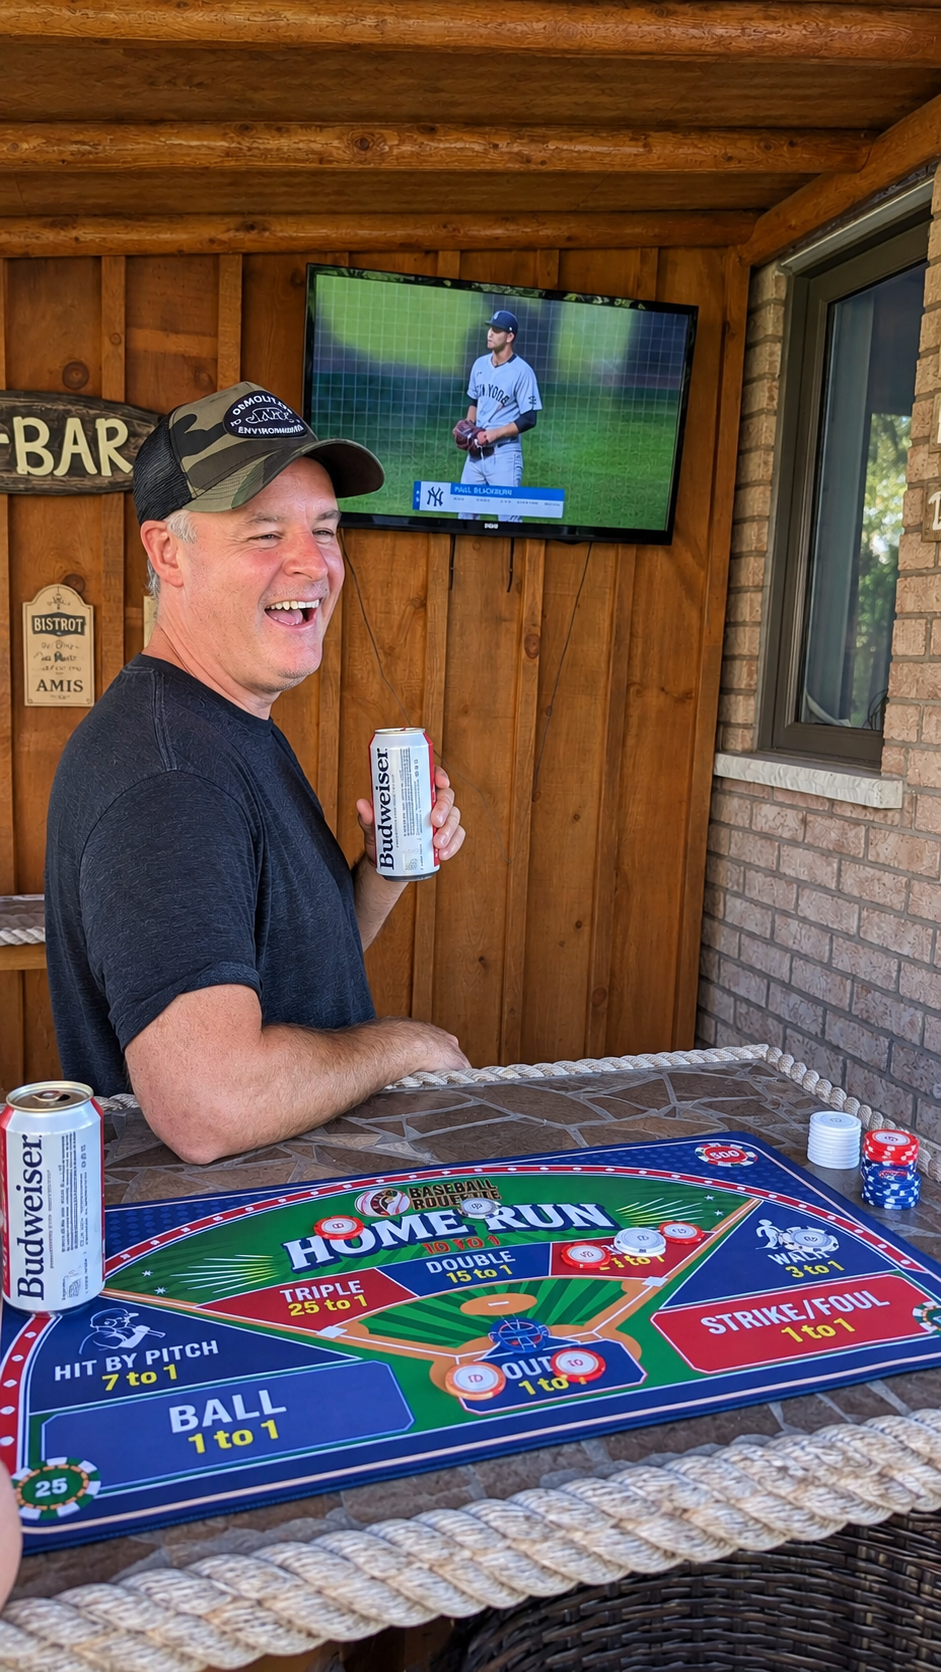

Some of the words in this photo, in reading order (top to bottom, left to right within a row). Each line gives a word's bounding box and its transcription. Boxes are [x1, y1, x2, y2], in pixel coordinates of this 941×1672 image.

[34, 617, 83, 632] BISTROT
[36, 679, 83, 693] AMIS
[376, 748, 395, 870] Budweiser
[408, 1178, 498, 1199] BASEBALL
[16, 1134, 44, 1301] Budweiser
[282, 1209, 469, 1271] HOME
[485, 1202, 615, 1231] RUN
[426, 1251, 516, 1274] DOUBLE
[446, 1271, 463, 1284] 15
[472, 1267, 498, 1280] to
[501, 1264, 513, 1276] 1
[785, 1266, 804, 1278] 3
[804, 1264, 829, 1275] to
[828, 1260, 845, 1271] 1
[280, 1280, 364, 1303] TRIPLE
[288, 1301, 321, 1317] 25
[324, 1298, 351, 1312] to
[354, 1294, 368, 1307] 1
[700, 1290, 890, 1335] STRIKE/FOUL
[781, 1326, 804, 1343] 1
[801, 1321, 836, 1338] to
[833, 1317, 855, 1333] 1
[54, 1360, 98, 1381] HIT
[105, 1353, 138, 1372] BY
[146, 1340, 219, 1365] PITCH
[501, 1356, 553, 1380] OUT
[101, 1374, 119, 1391] 7
[126, 1370, 157, 1387] to
[163, 1364, 178, 1380] 1
[518, 1380, 536, 1395] 1
[537, 1375, 569, 1391] to
[169, 1390, 286, 1434] BALL
[188, 1434, 206, 1454] 1
[213, 1427, 254, 1450] to
[261, 1420, 279, 1440] 1
[35, 1477, 68, 1498] 25
